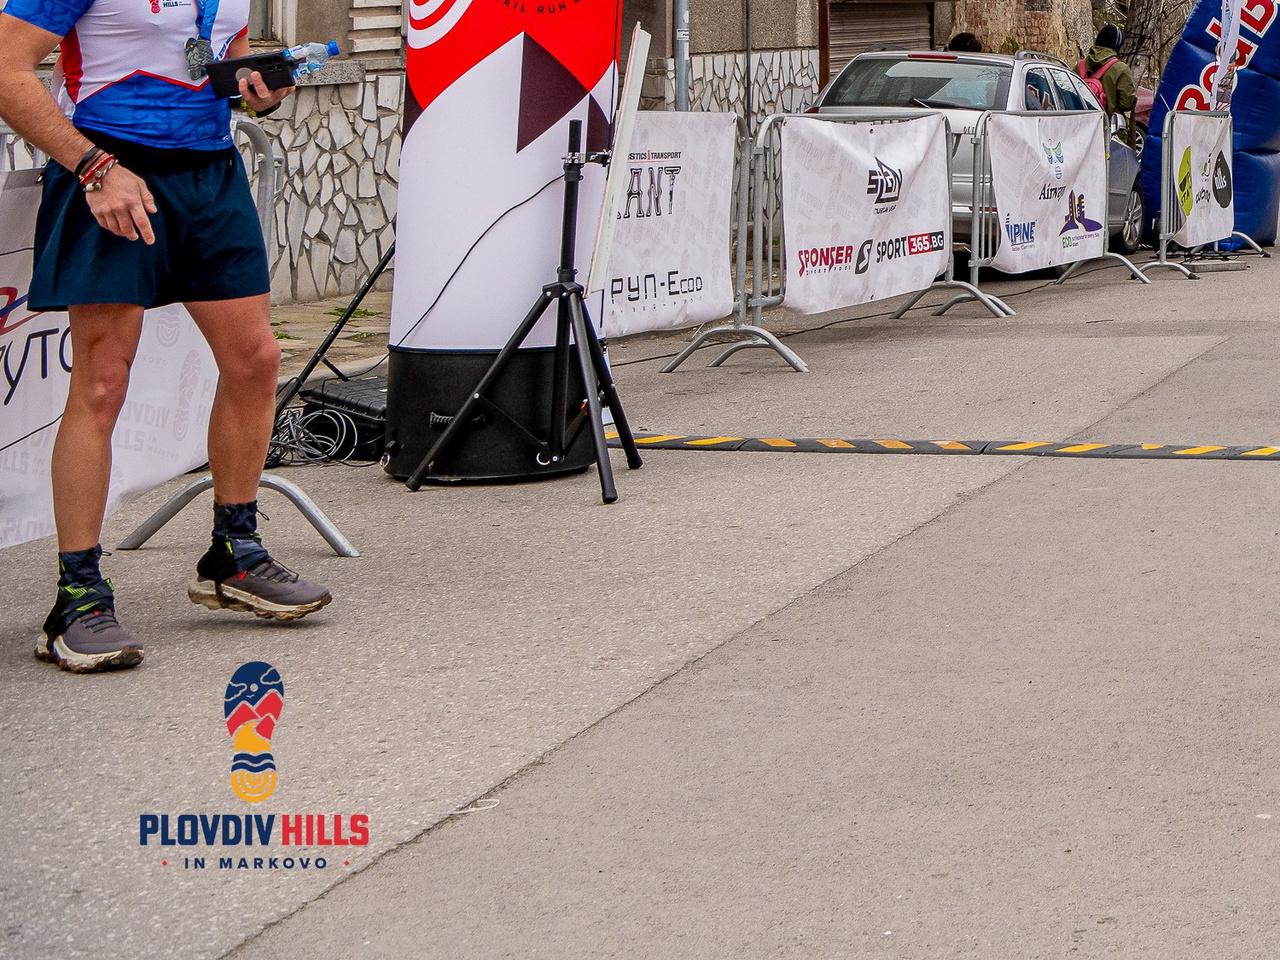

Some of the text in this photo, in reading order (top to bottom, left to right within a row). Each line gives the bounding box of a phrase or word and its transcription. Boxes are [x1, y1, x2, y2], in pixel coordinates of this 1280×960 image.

[537, 2, 567, 14] RUN
[651, 151, 682, 160] TRANSPORT
[798, 245, 854, 278] SPONSER
